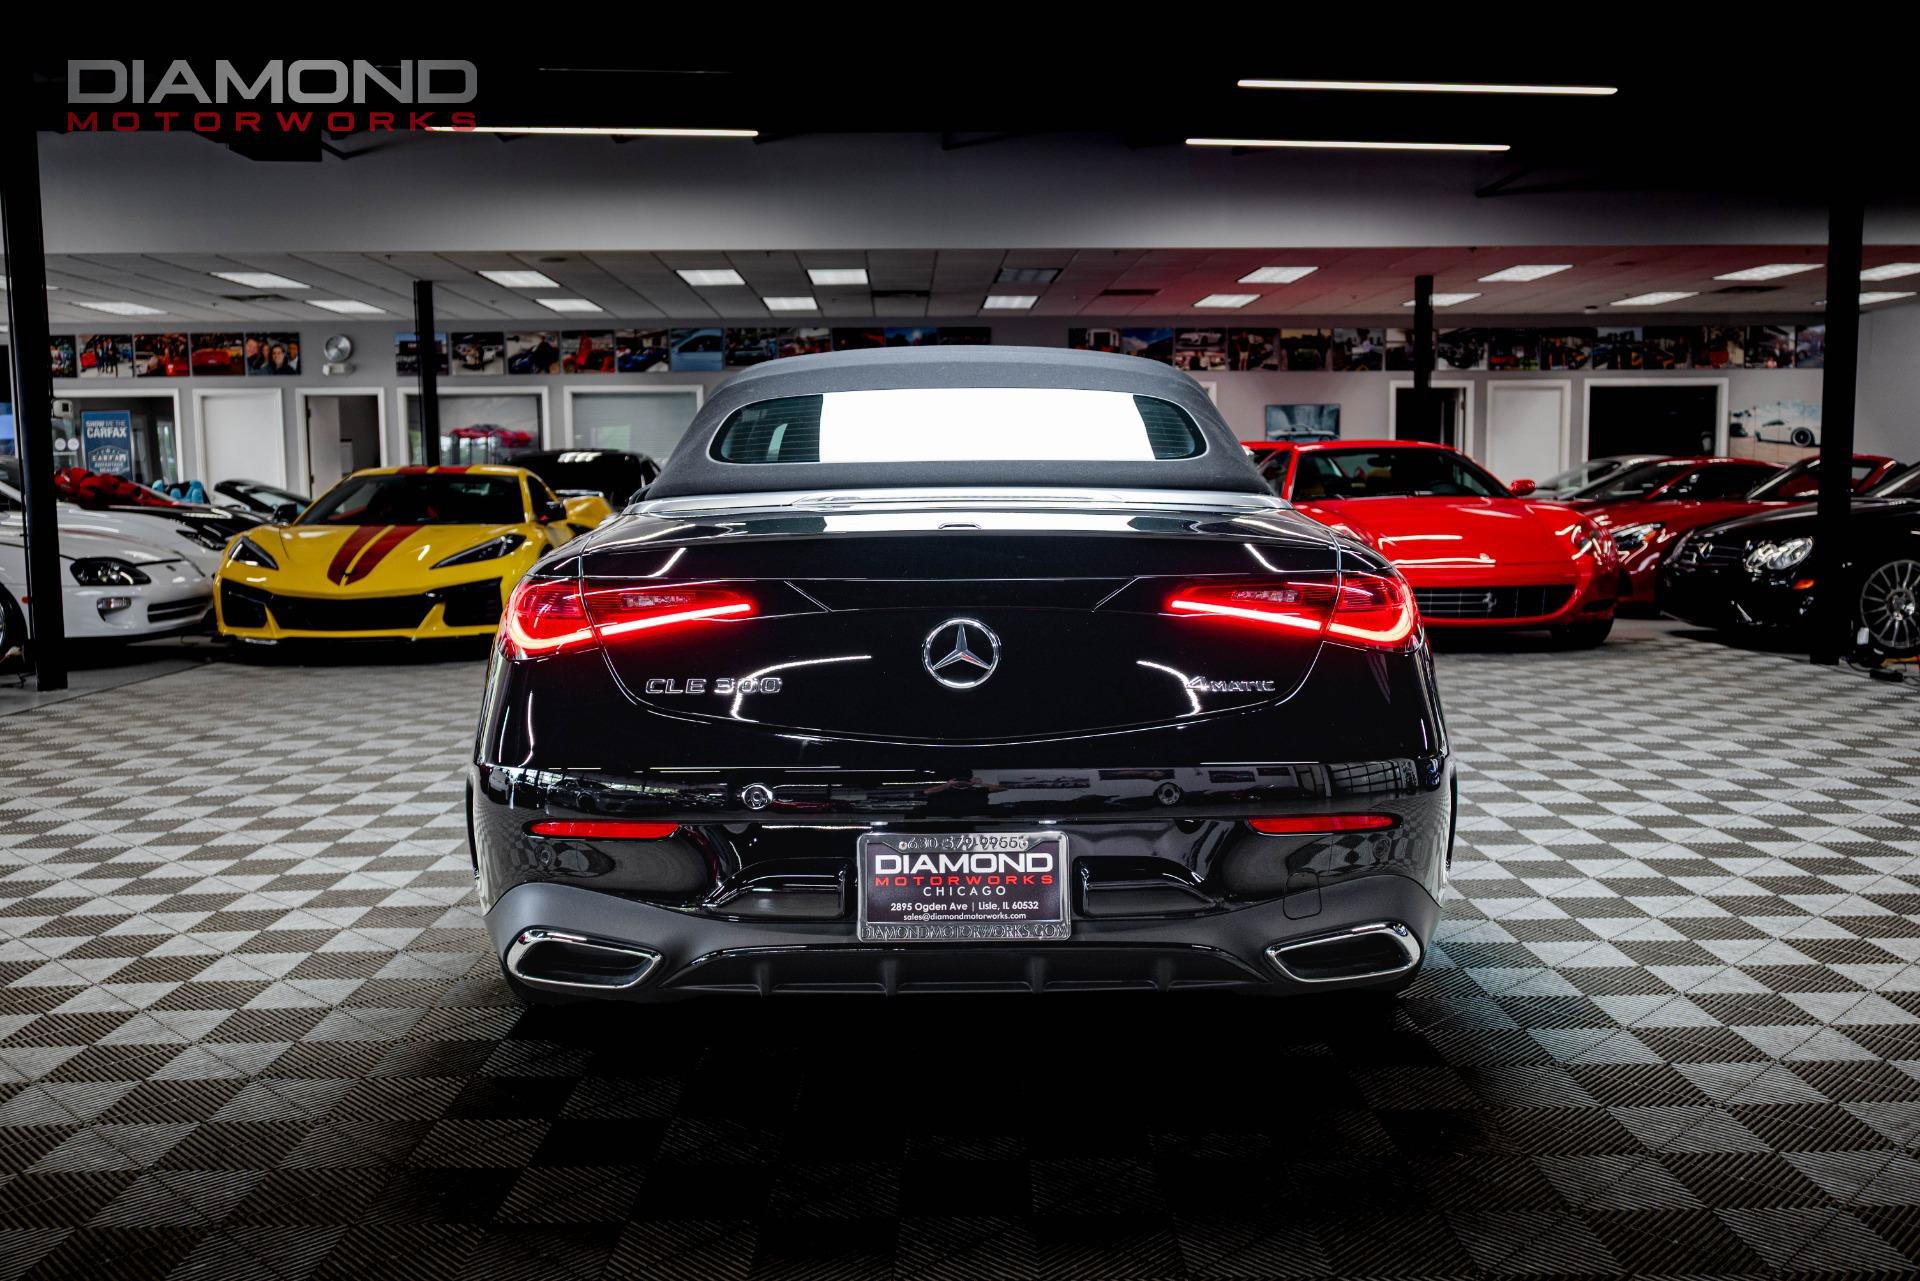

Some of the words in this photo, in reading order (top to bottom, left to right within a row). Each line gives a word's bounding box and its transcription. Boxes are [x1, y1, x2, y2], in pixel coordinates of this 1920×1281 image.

[87, 427, 127, 439] CARFAX
[645, 678, 707, 694] CLE
[713, 677, 782, 694] 300
[1186, 675, 1275, 692] 4MATIC
[875, 853, 1053, 874] DIAMOND
[875, 875, 1054, 886] MOTORWORKS
[923, 886, 1006, 896] CHICAGO
[890, 902, 912, 911] 2895
[915, 902, 947, 912] Ogden
[949, 902, 968, 910] Ave
[978, 902, 1000, 911] Lisle,
[1003, 901, 1010, 910] IL
[1012, 901, 1039, 910] 60532
[903, 912, 1027, 922] sales@diamondmotorworks.com
